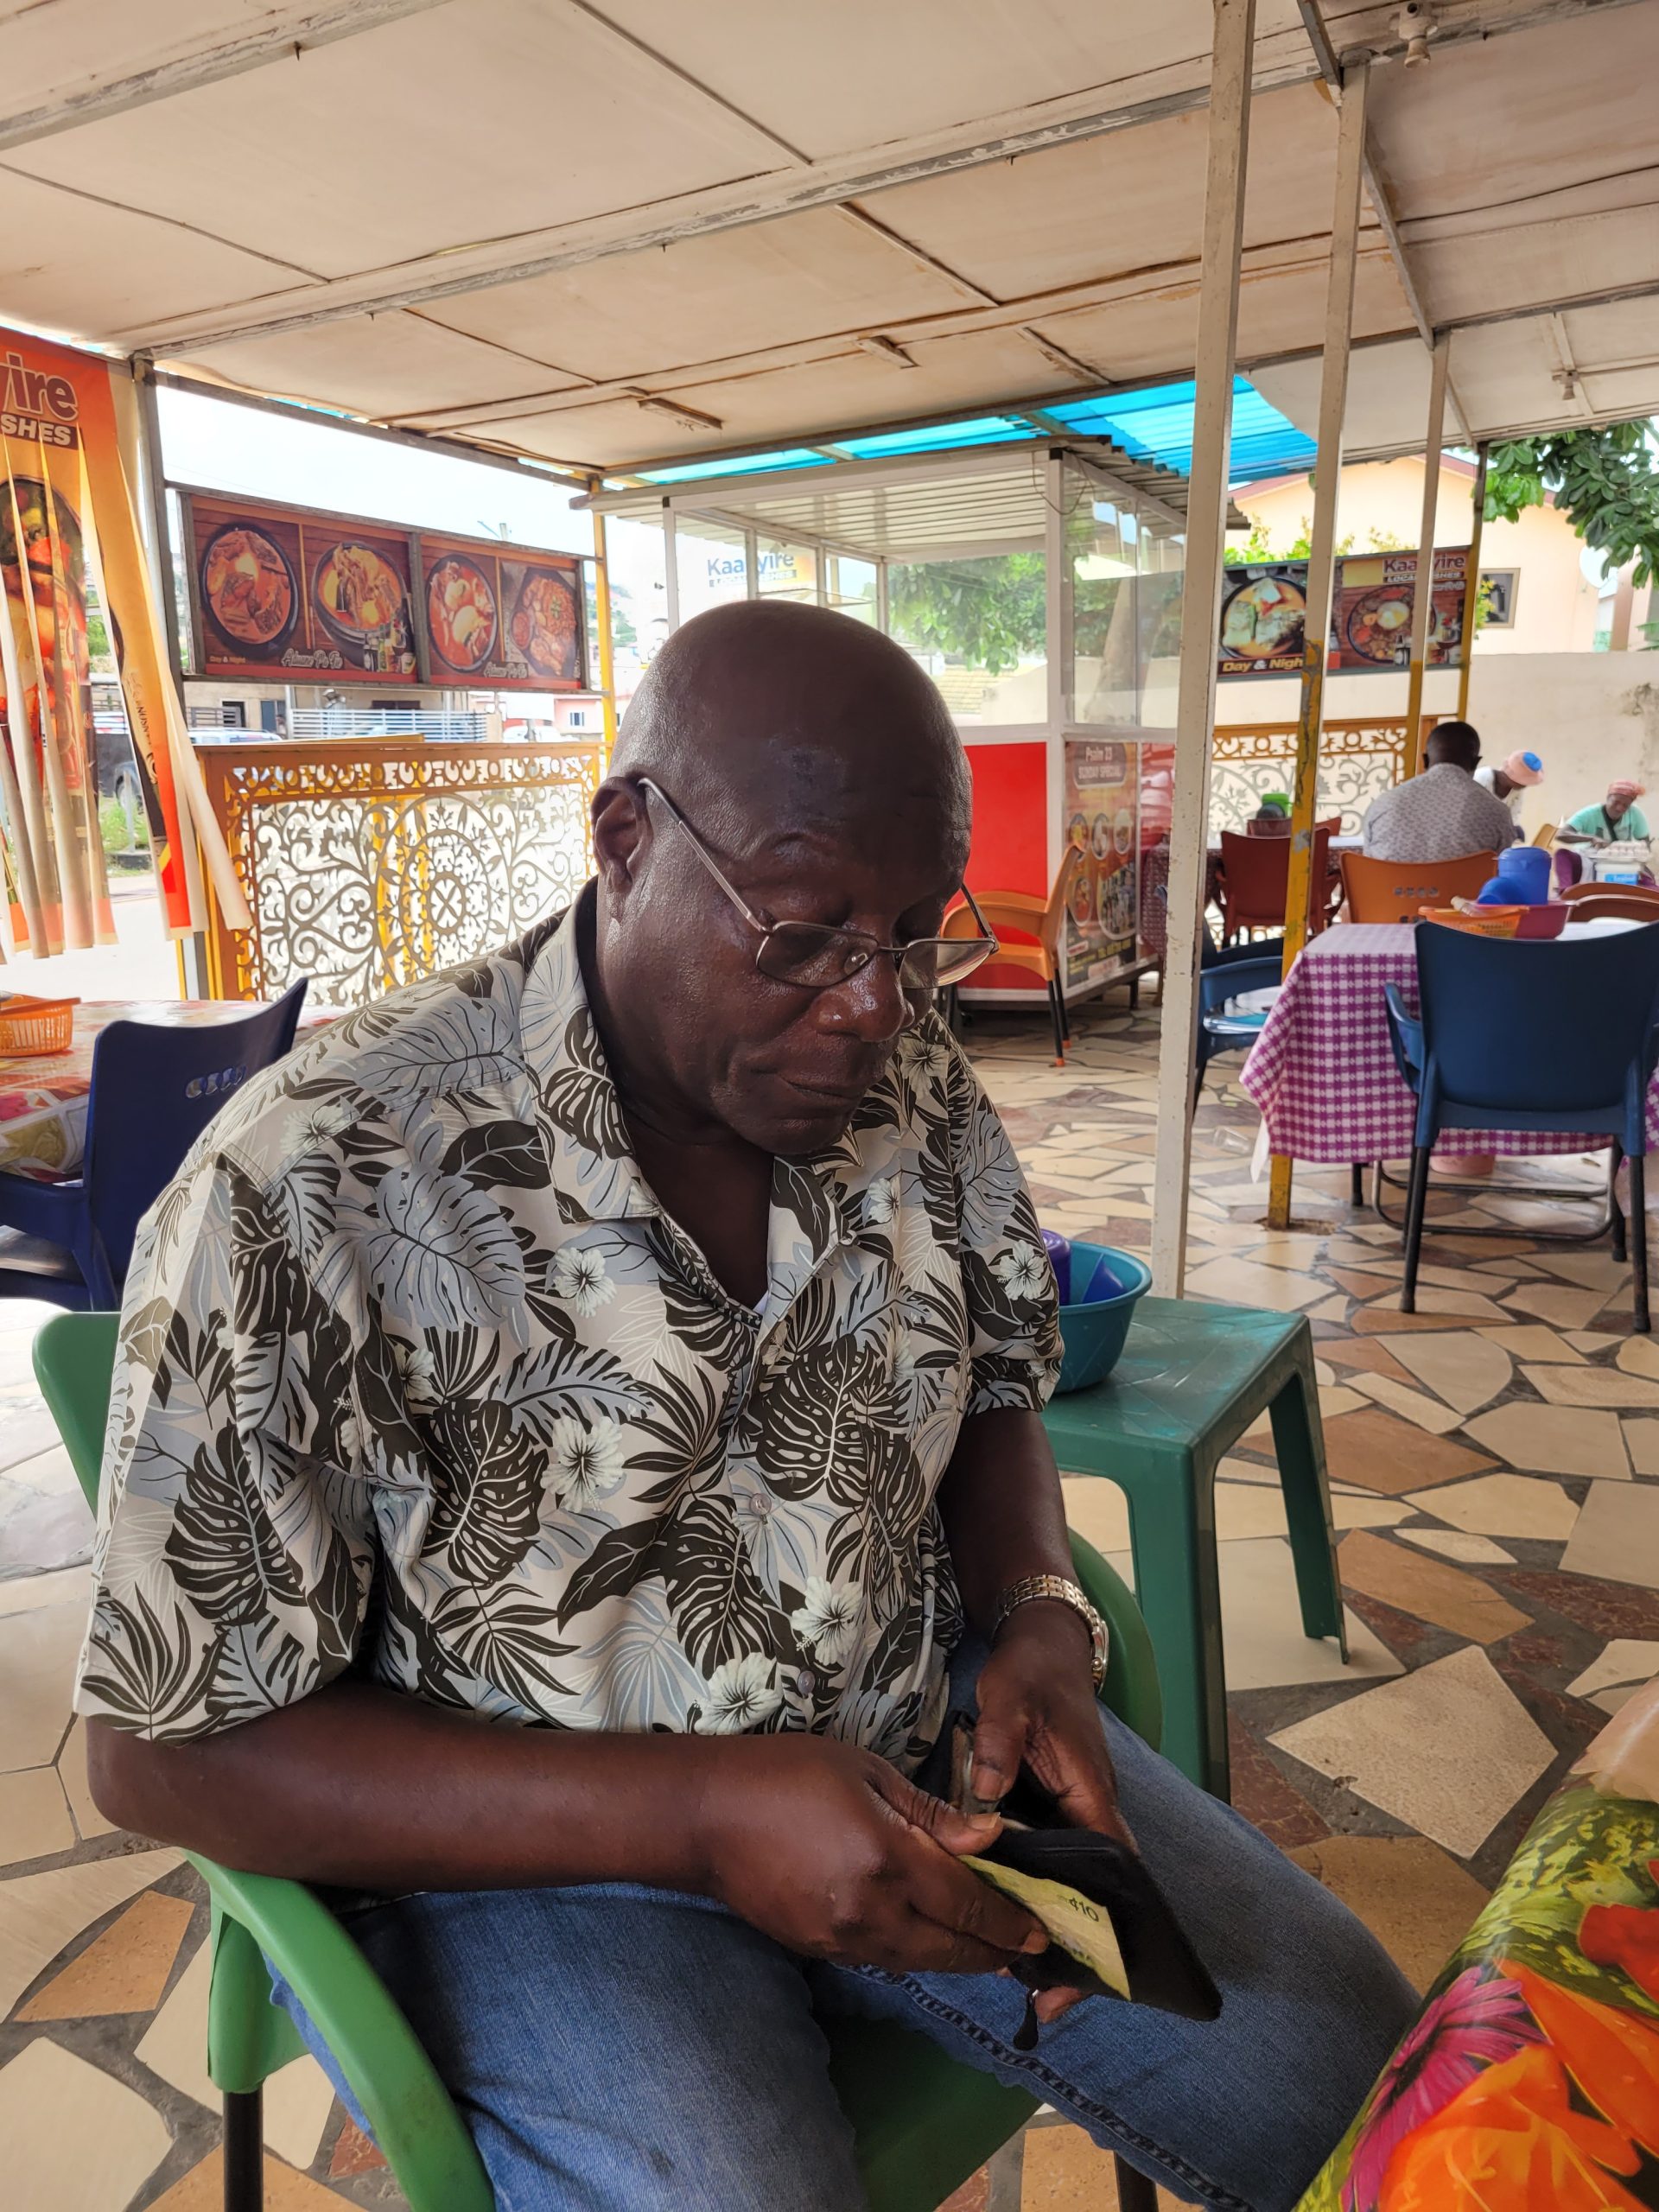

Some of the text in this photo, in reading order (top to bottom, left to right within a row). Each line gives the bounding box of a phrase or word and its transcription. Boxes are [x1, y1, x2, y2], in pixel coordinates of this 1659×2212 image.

[708, 553, 794, 576] Kaayire
[1223, 658, 1303, 673] Day & Nigh
